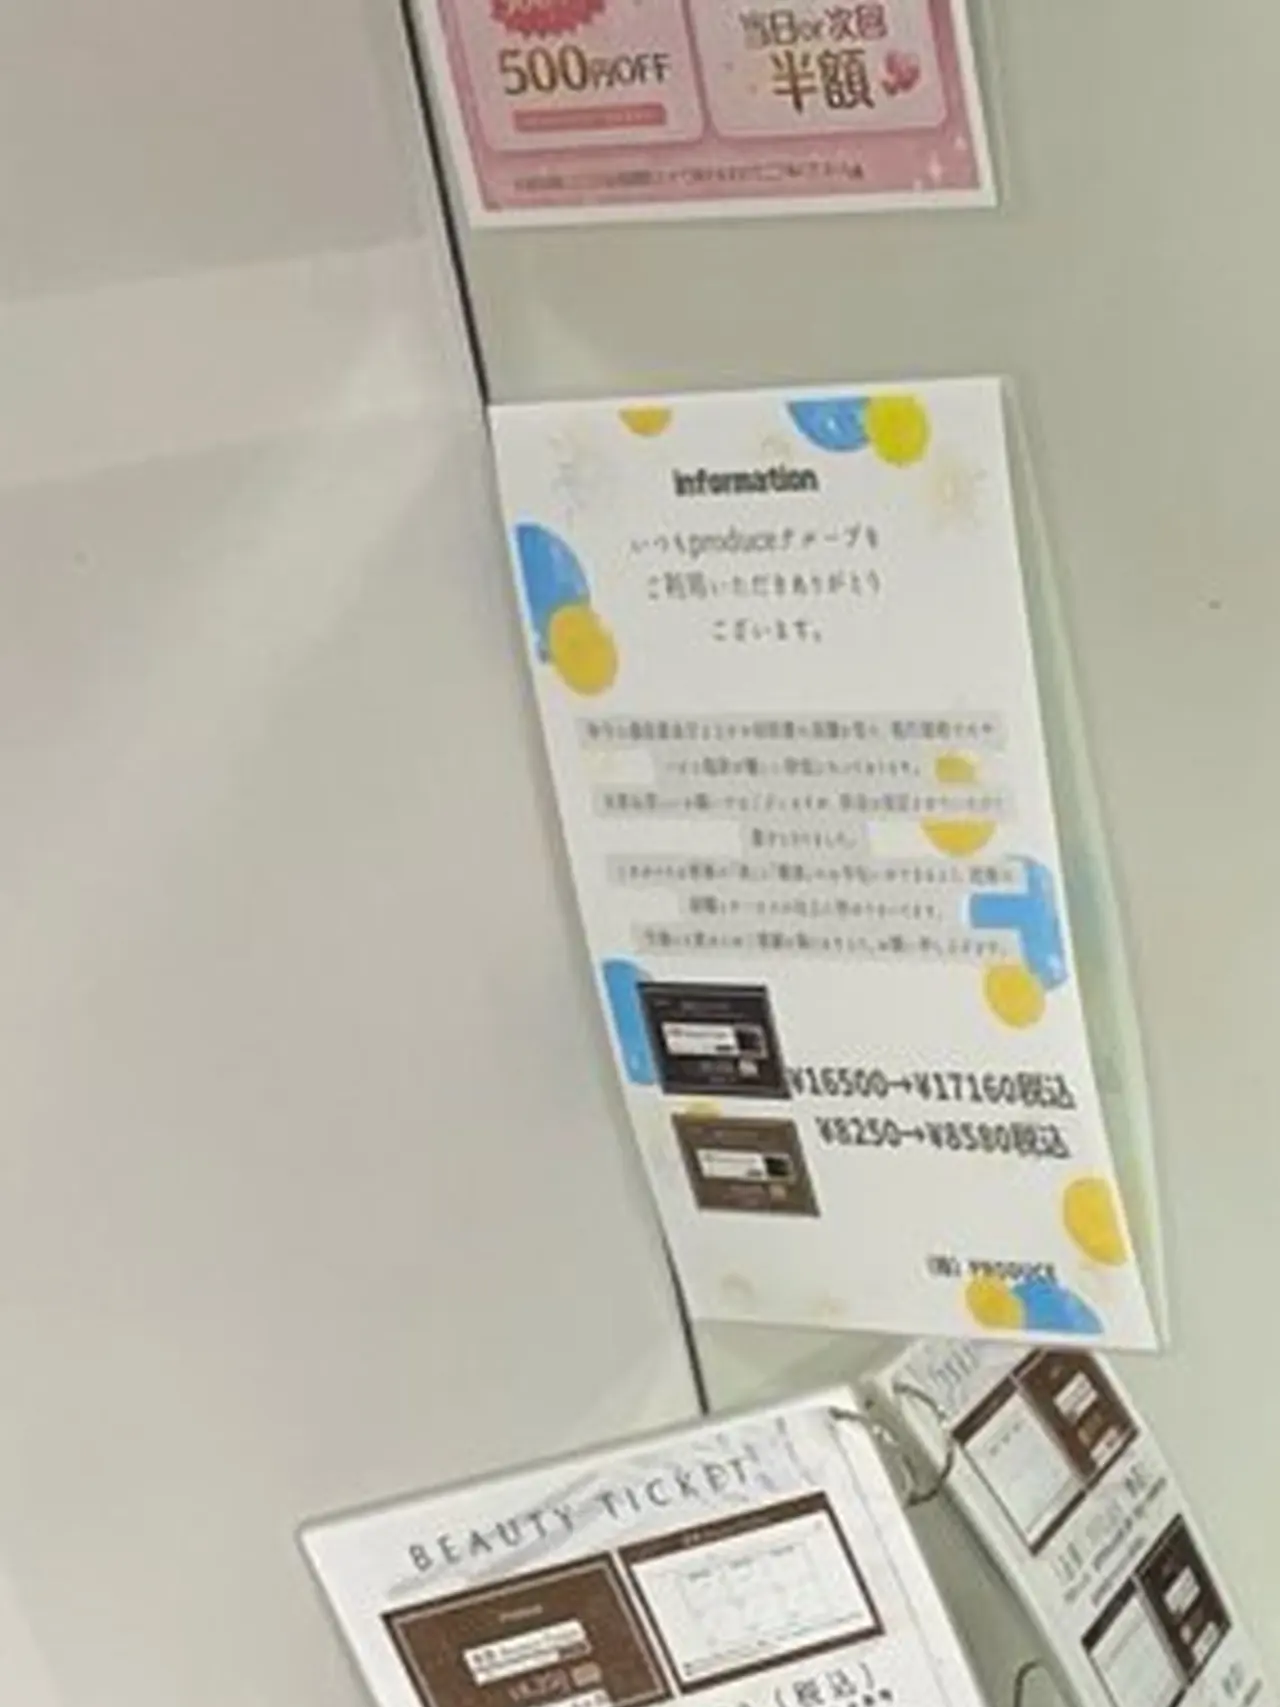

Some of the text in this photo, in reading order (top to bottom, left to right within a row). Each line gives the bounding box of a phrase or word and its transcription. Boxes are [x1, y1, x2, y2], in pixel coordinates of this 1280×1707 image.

[770, 49, 876, 114] 半額
[408, 1457, 750, 1571] BEAUTY TICKET
